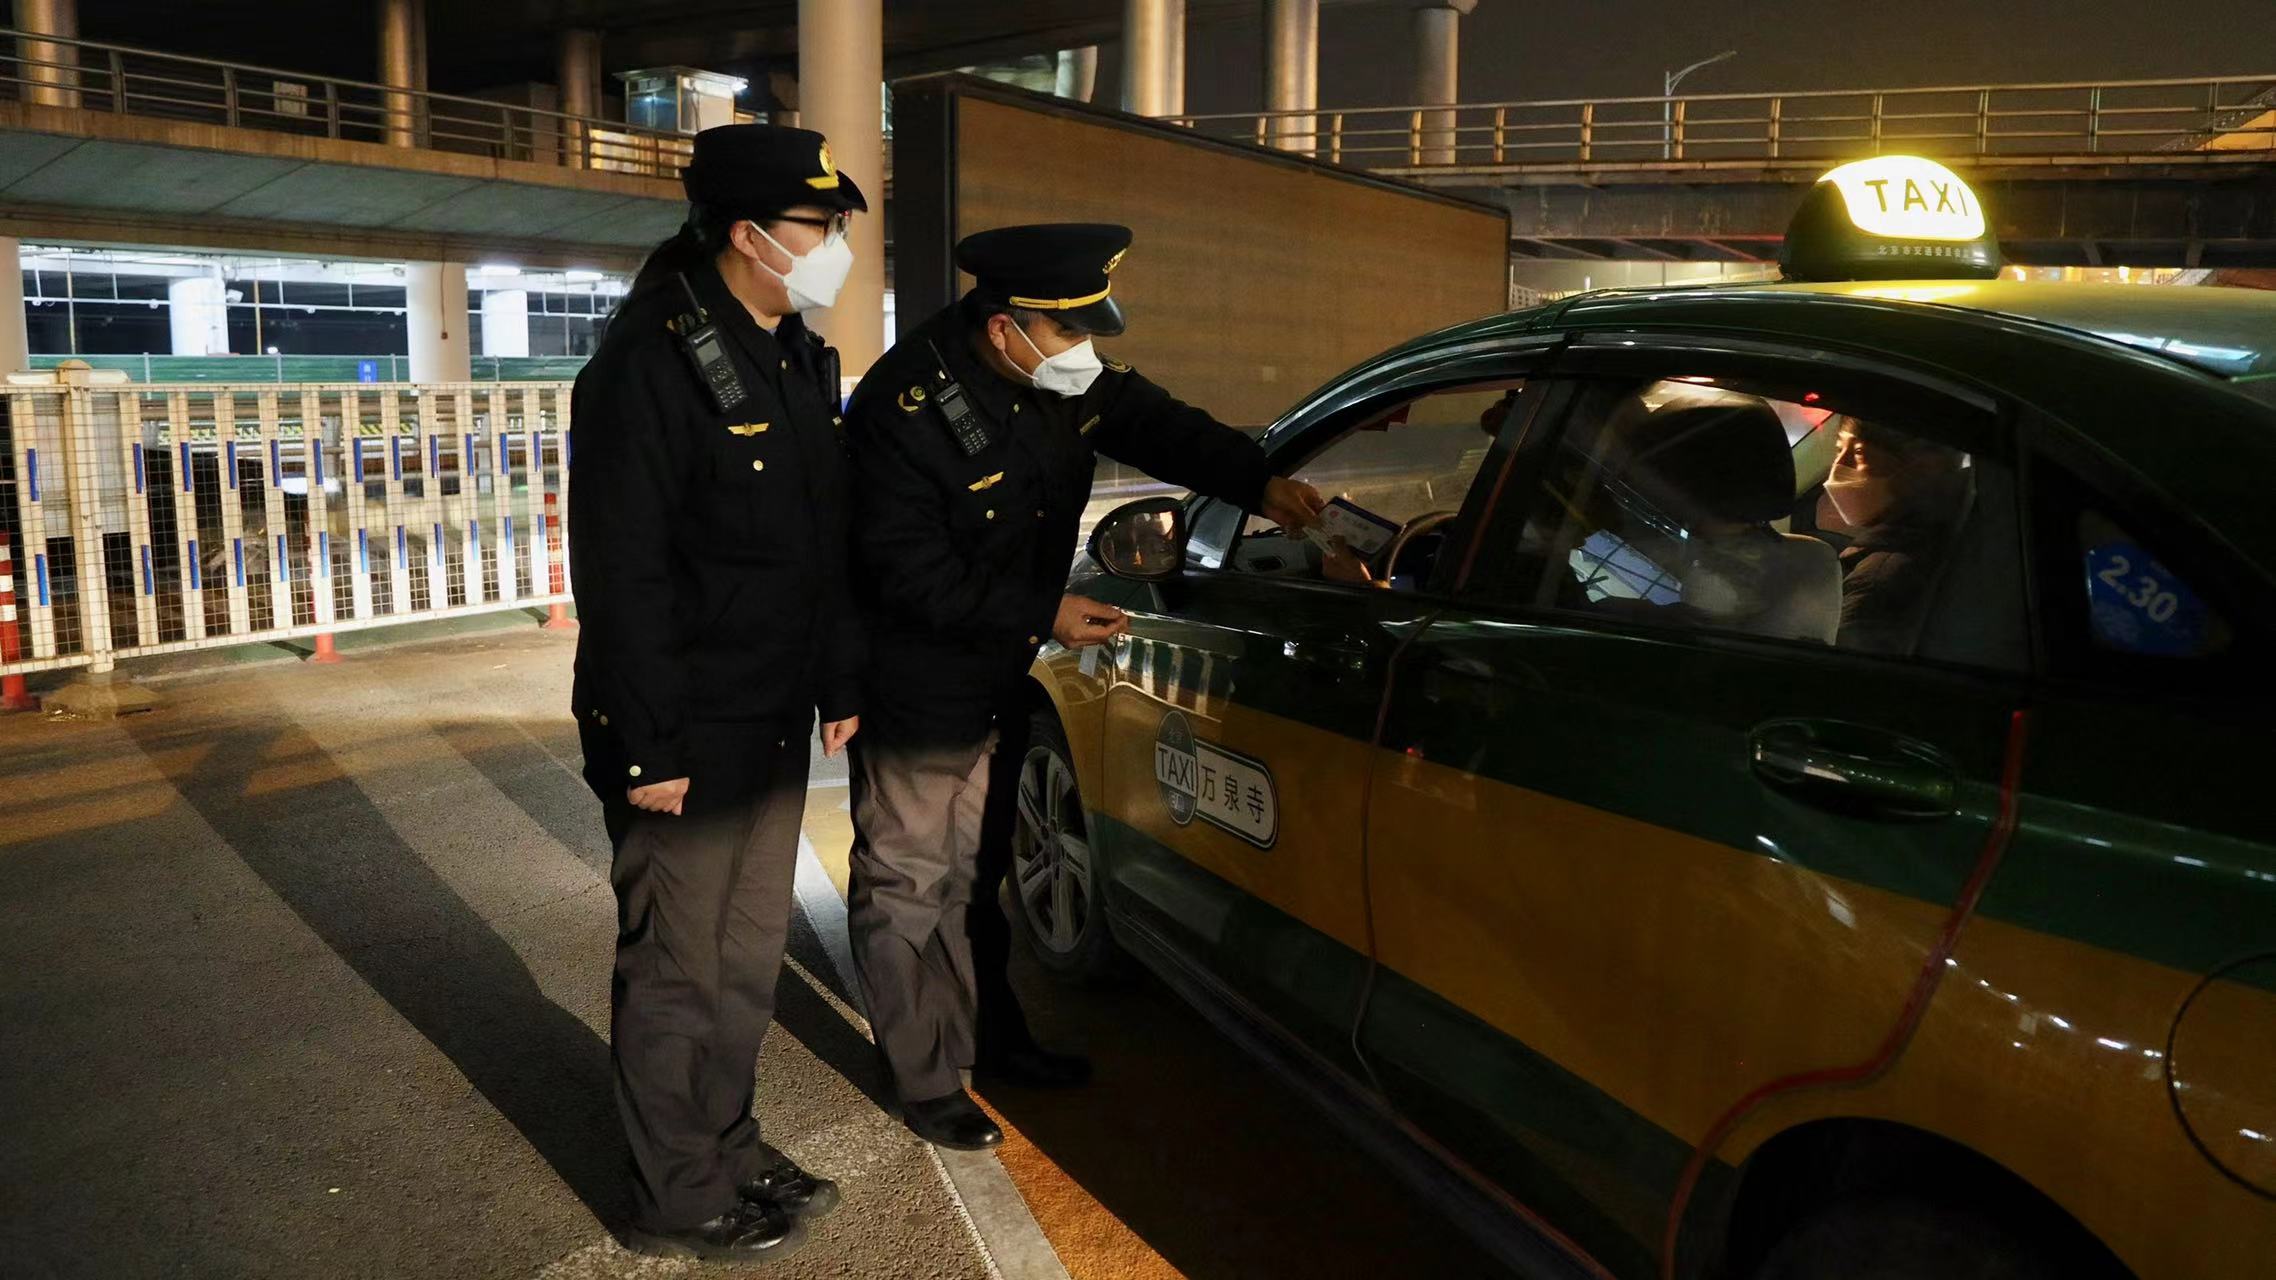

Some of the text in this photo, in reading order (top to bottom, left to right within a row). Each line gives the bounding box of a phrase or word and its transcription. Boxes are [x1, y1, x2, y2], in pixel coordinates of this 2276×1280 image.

[1865, 179, 1968, 216] TAXI
[2098, 555, 2178, 623] 2.30
[1158, 748, 1195, 792] TAXI
[1201, 766, 1265, 824] 万泉寺
